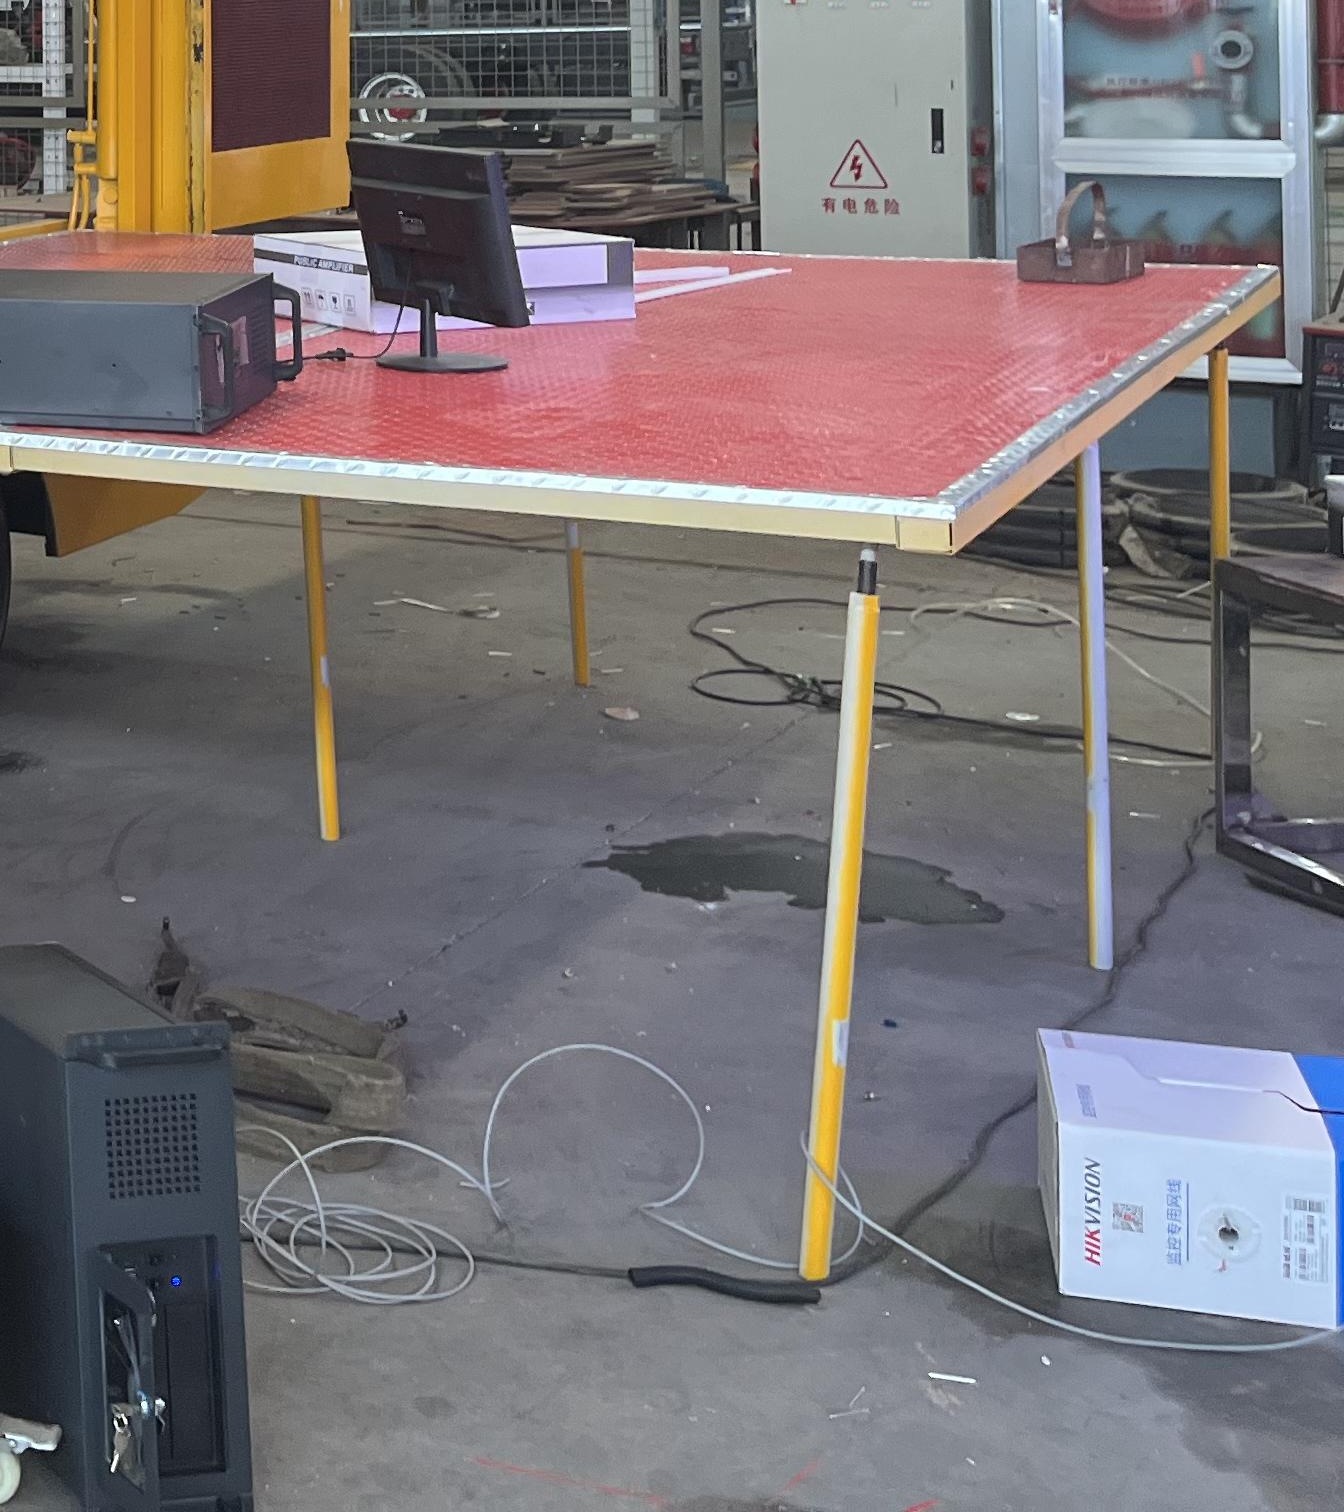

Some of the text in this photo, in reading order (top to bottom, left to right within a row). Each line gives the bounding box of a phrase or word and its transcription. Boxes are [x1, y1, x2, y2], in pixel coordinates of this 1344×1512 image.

[821, 198, 900, 215] 有电危险
[293, 255, 354, 273] PUBLIC AMPLIFIER
[1084, 1157, 1101, 1266] HIKVISION
[1165, 1178, 1183, 1266] 监控专用网线
